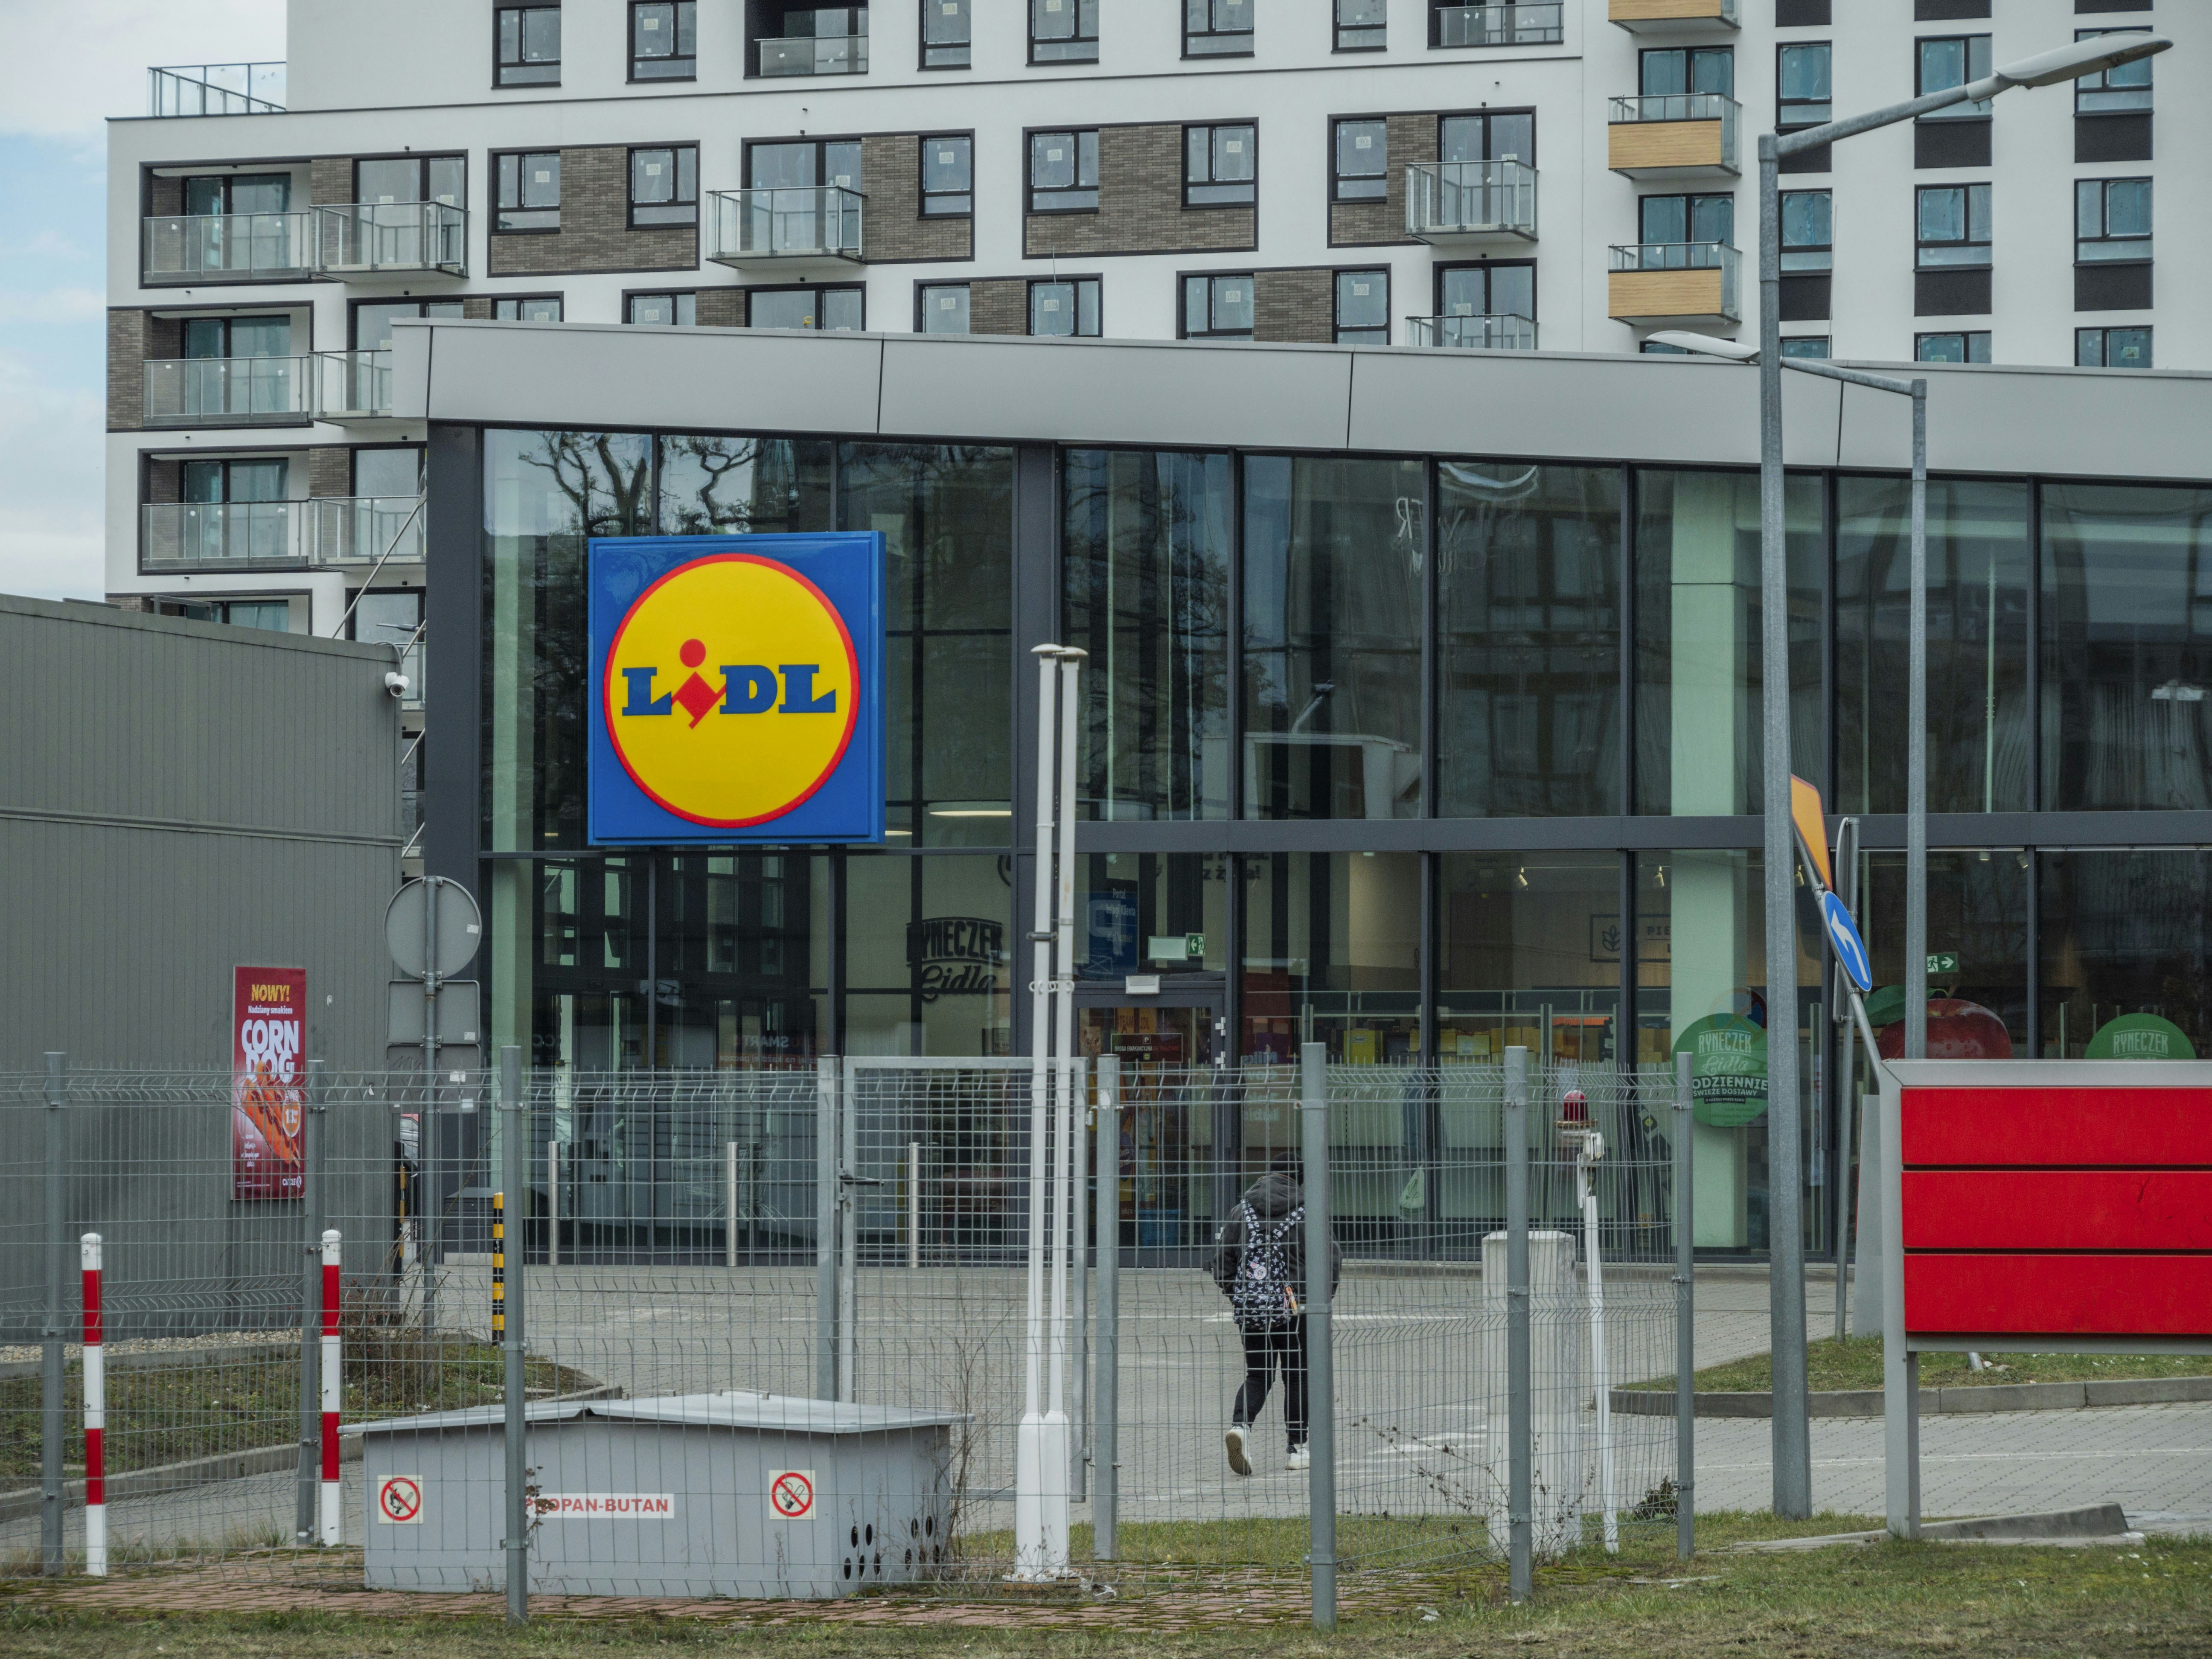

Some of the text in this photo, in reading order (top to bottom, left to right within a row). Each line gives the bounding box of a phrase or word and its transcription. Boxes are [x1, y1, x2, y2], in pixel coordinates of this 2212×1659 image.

[251, 984, 290, 1002] NOWY!
[248, 1005, 293, 1016] Nadziany smakiem
[241, 1019, 299, 1054] CORN
[1698, 1031, 1752, 1054] RYNECZEK
[2113, 1032, 2168, 1055] RYNECZEK
[244, 1049, 295, 1083] DOG
[1701, 1055, 1749, 1077] Lidla
[1692, 1077, 1768, 1090] ODZIENNIE
[1693, 1087, 1757, 1097] ŚWIEŻE DOSTAWY
